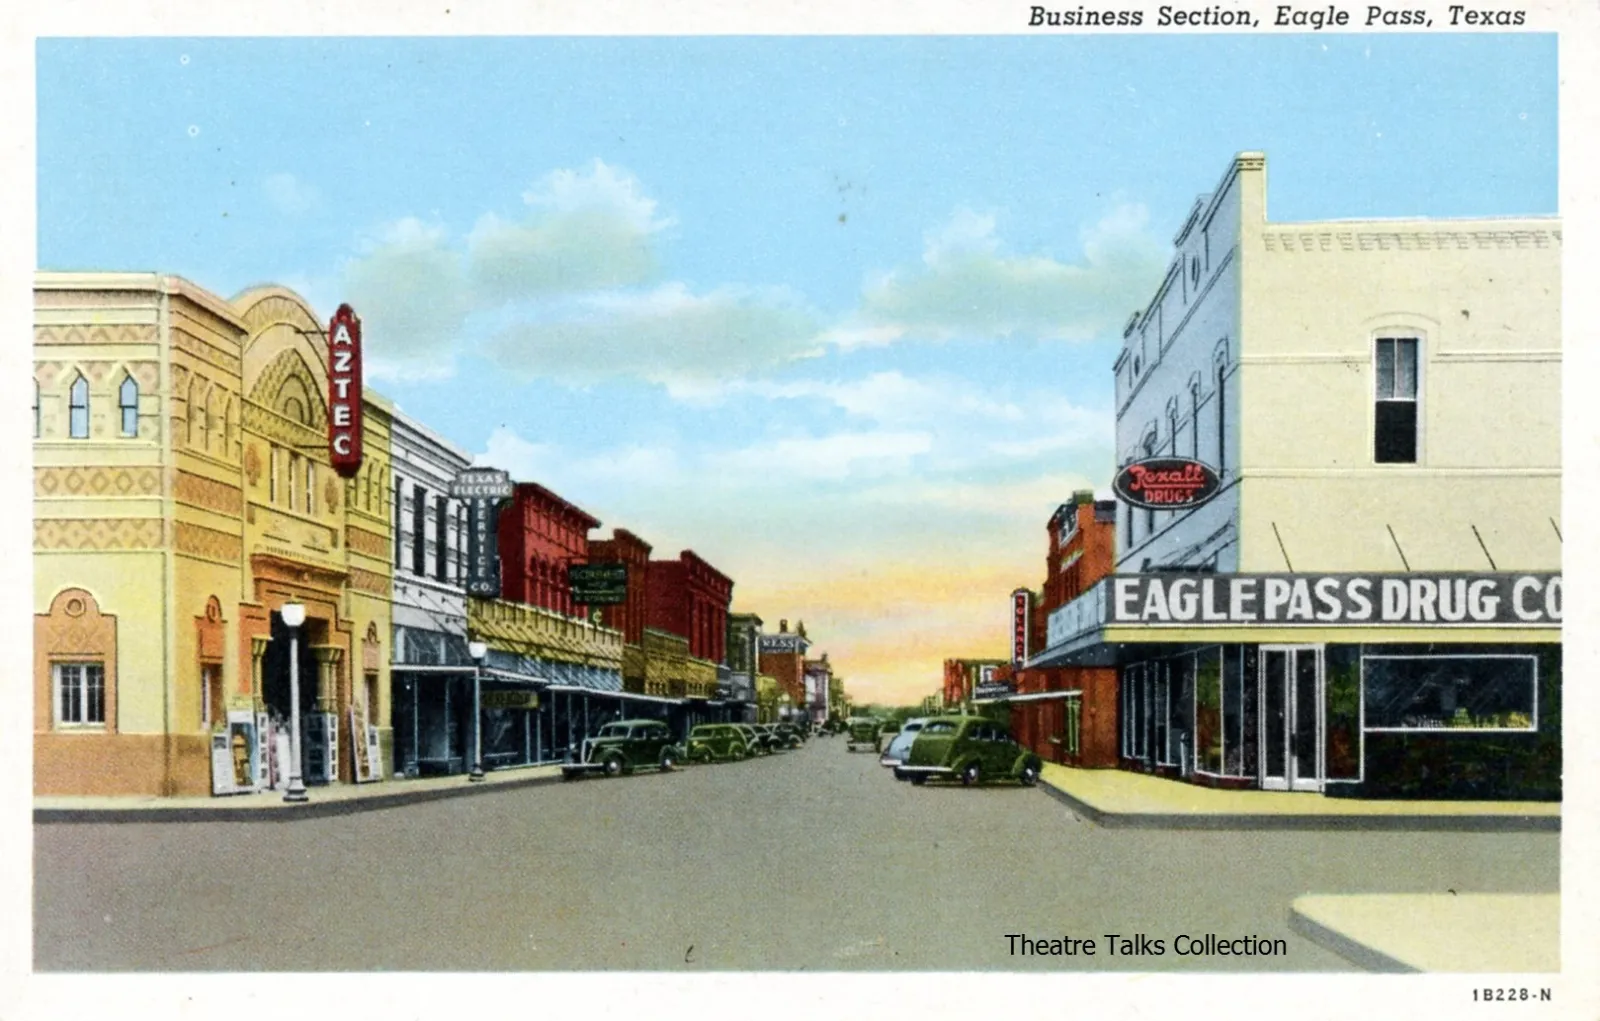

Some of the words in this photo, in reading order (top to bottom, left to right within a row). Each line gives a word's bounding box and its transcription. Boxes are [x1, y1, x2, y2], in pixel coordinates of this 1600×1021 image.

[333, 325, 353, 455] AZTEC
[460, 473, 503, 484] TEXAS
[1128, 463, 1205, 491] Rexall
[453, 485, 512, 495] ELECTRIC
[1144, 489, 1194, 503] DRUGS
[477, 499, 486, 578] SERVICE
[470, 581, 493, 592] CO.
[1114, 578, 1257, 621] EAGLE
[1264, 577, 1373, 621] PASS
[1381, 577, 1501, 621] DRUG
